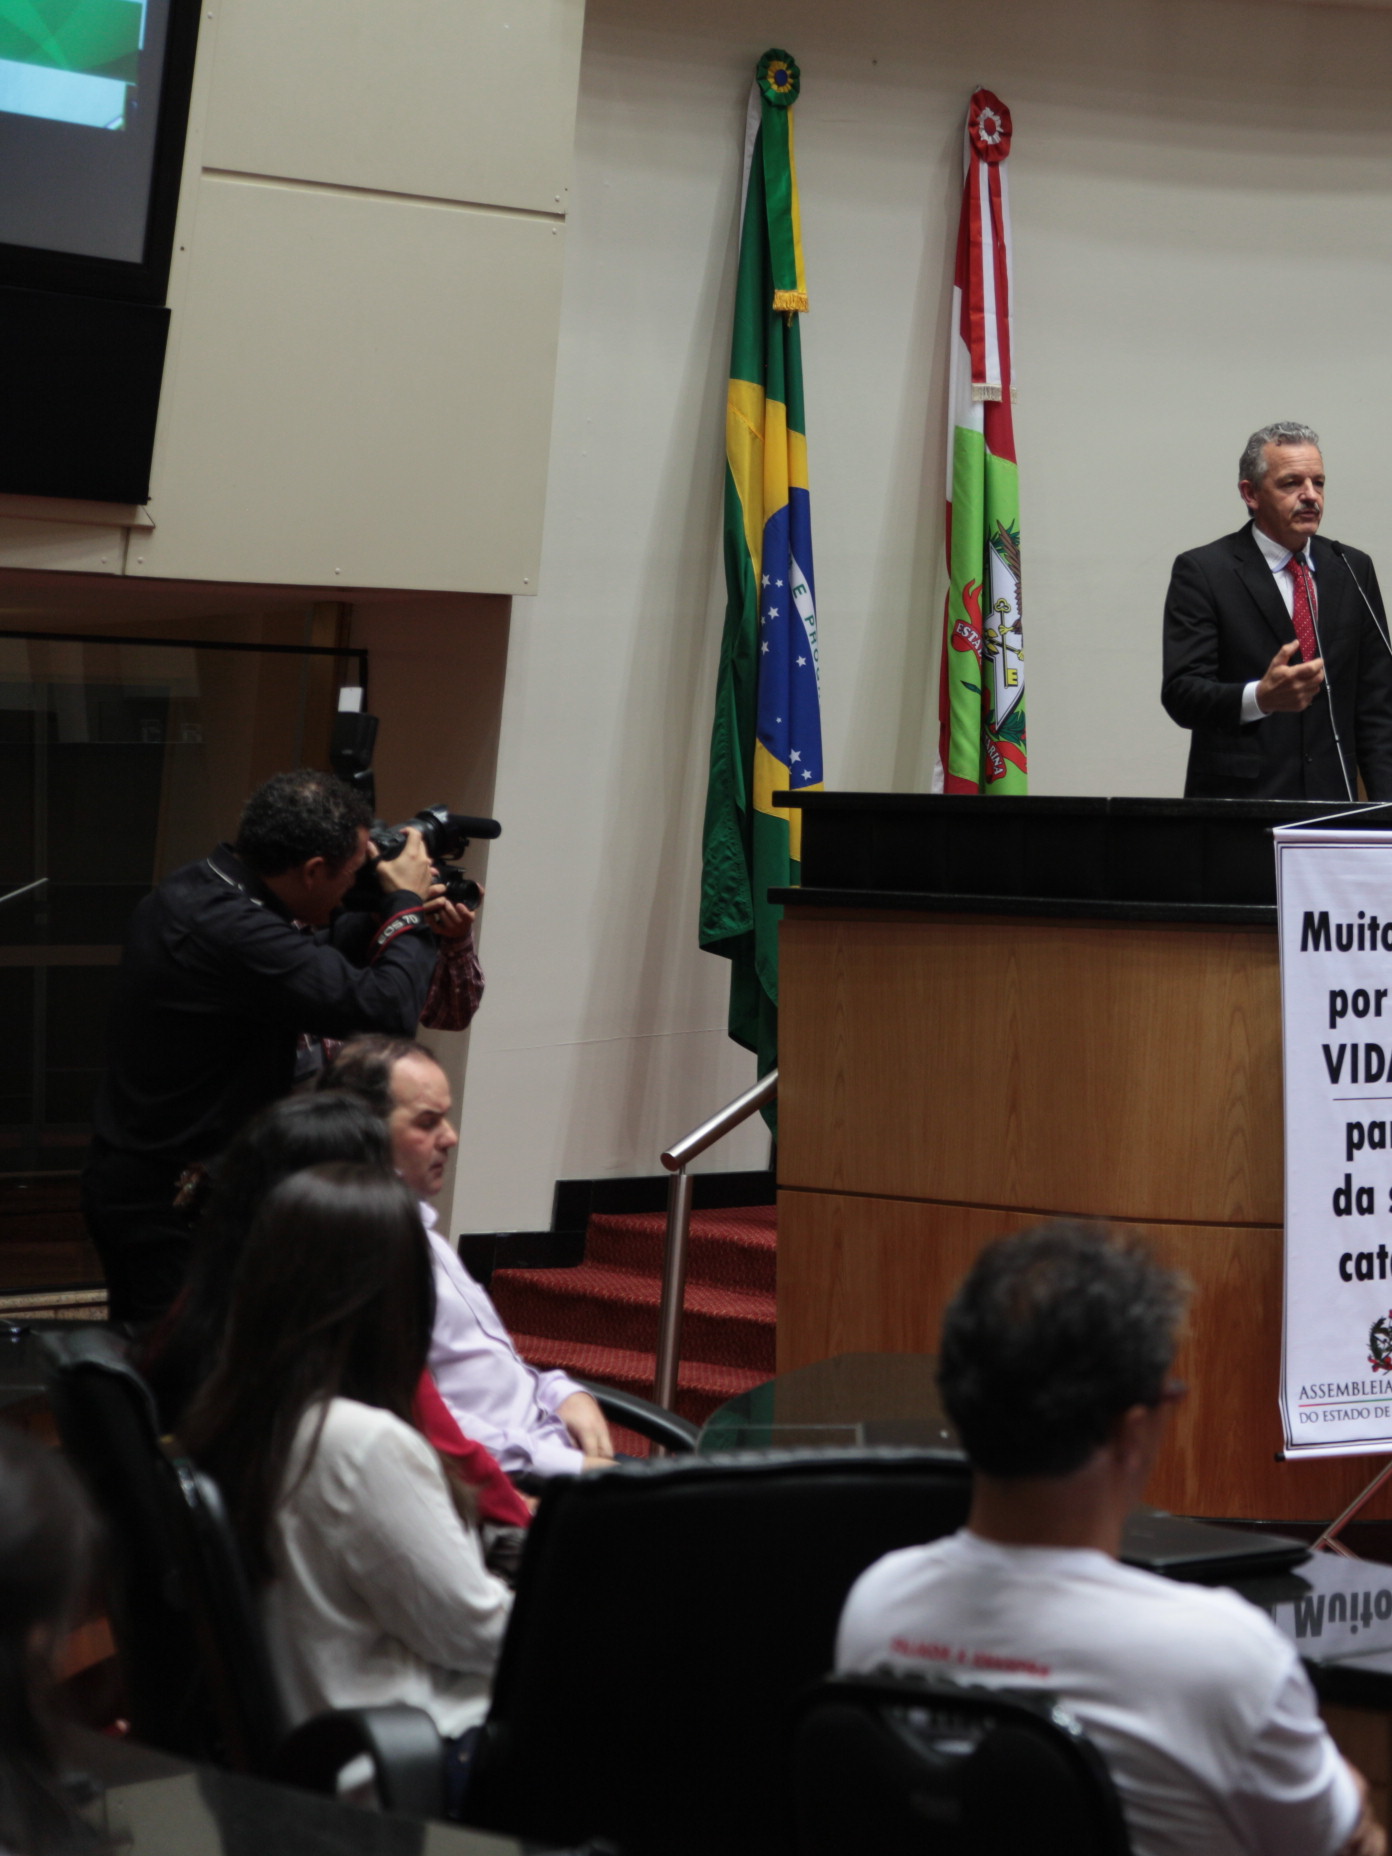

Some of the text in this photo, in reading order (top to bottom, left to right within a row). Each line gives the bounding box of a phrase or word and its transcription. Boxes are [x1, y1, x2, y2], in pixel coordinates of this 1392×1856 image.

[792, 584, 807, 598] E
[1329, 988, 1388, 1029] por
[1332, 1173, 1375, 1217] da
[1299, 1411, 1319, 1424] DO
[1323, 1407, 1371, 1422] ESTADO
[1374, 1404, 1390, 1418] DE
